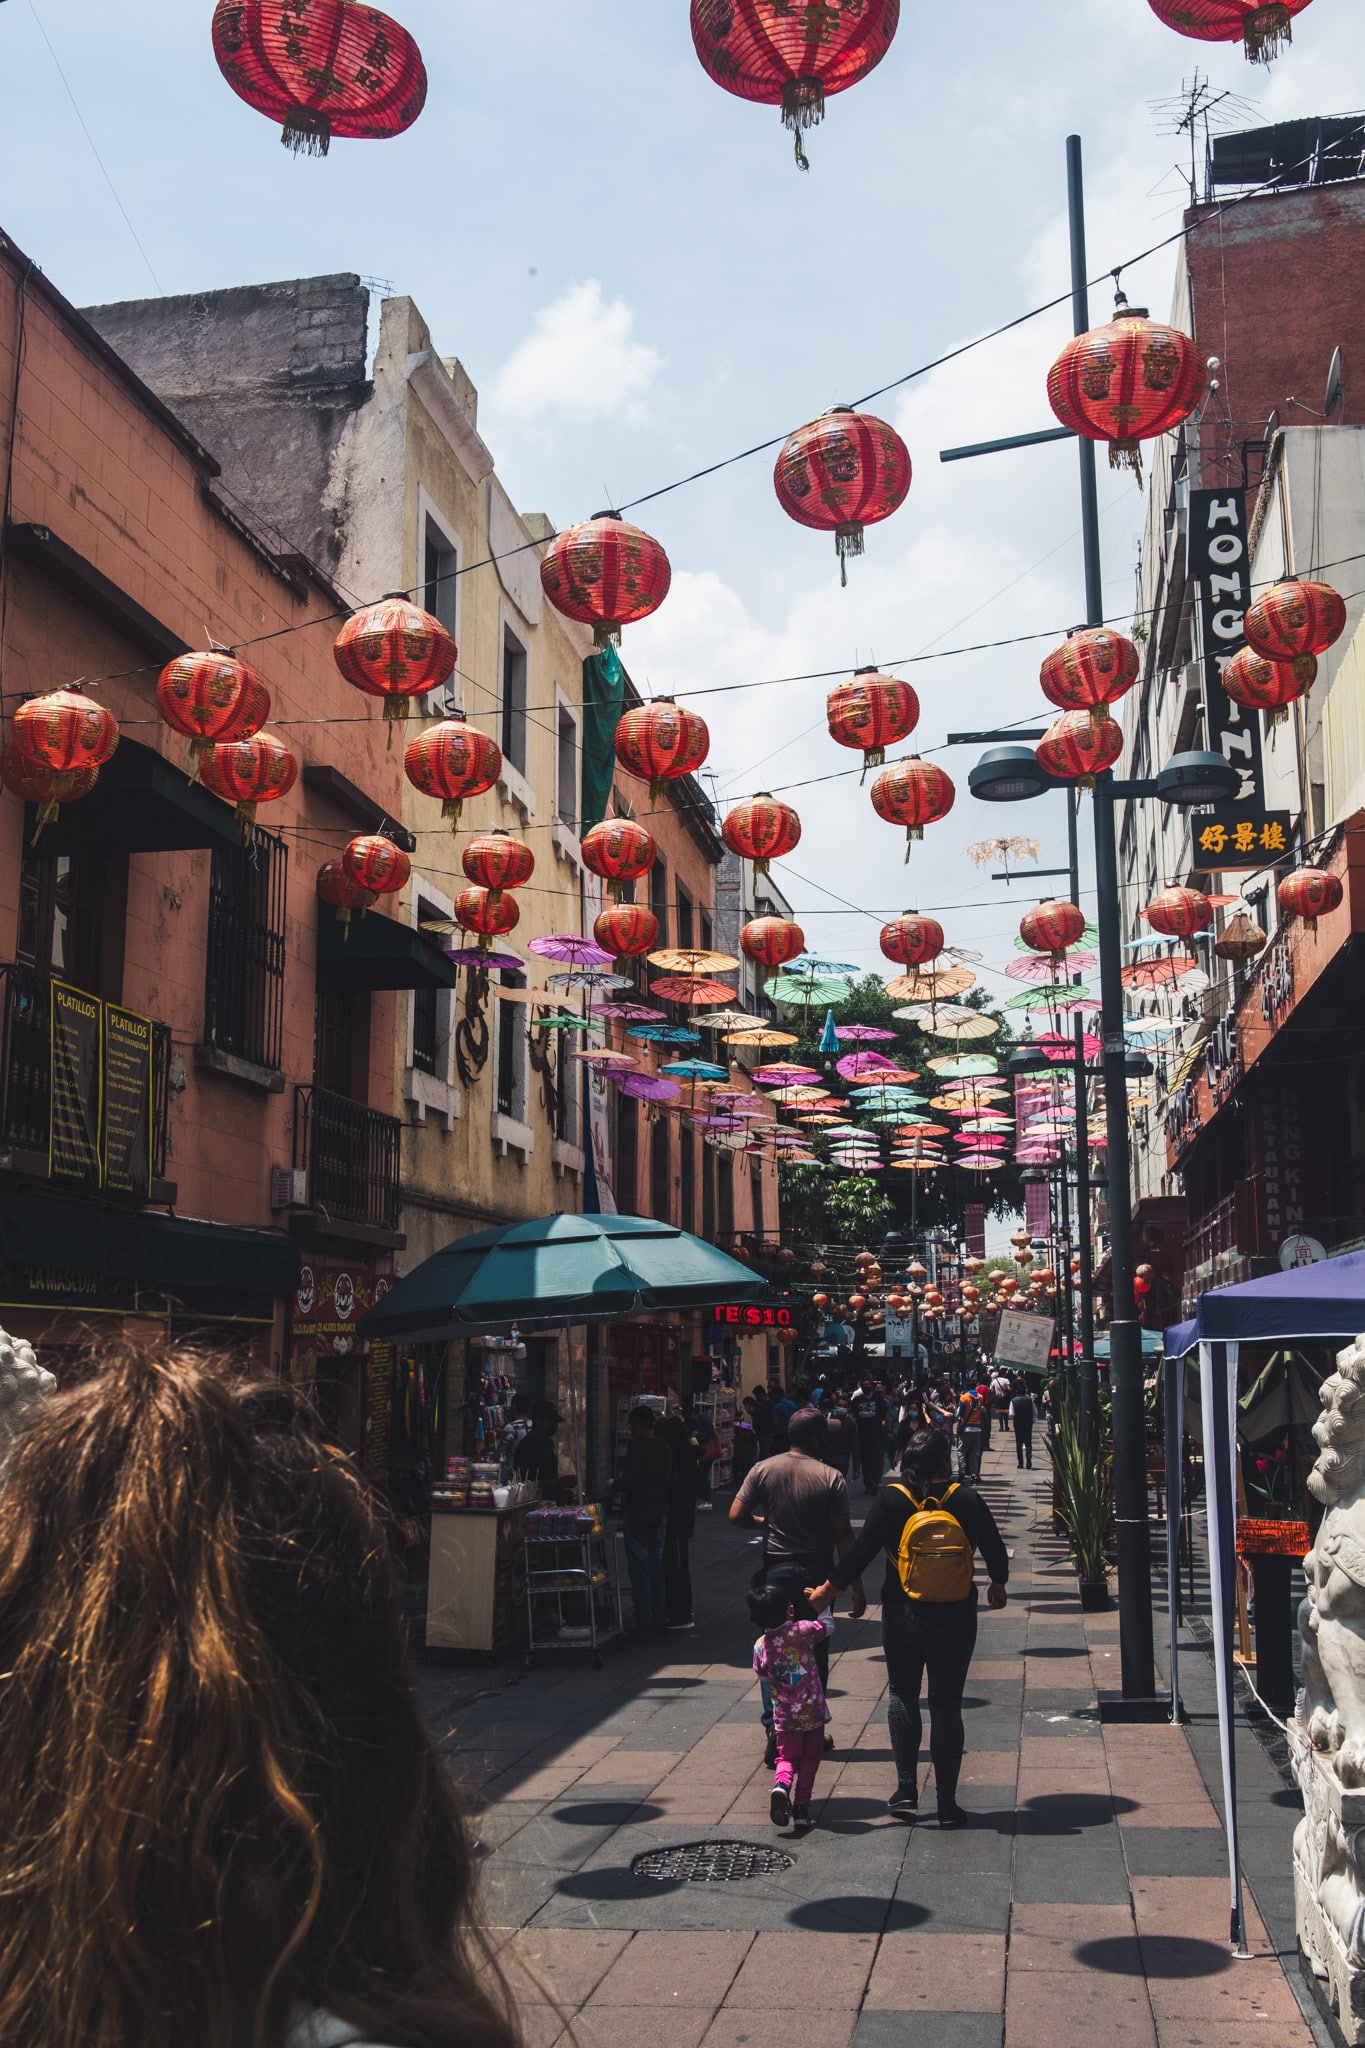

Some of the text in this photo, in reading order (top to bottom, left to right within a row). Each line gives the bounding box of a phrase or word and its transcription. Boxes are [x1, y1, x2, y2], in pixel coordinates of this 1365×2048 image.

[1198, 819, 1288, 854] 好景樓
[57, 991, 97, 1018] PLATILLOS
[111, 1014, 148, 1038] PLATILLOS
